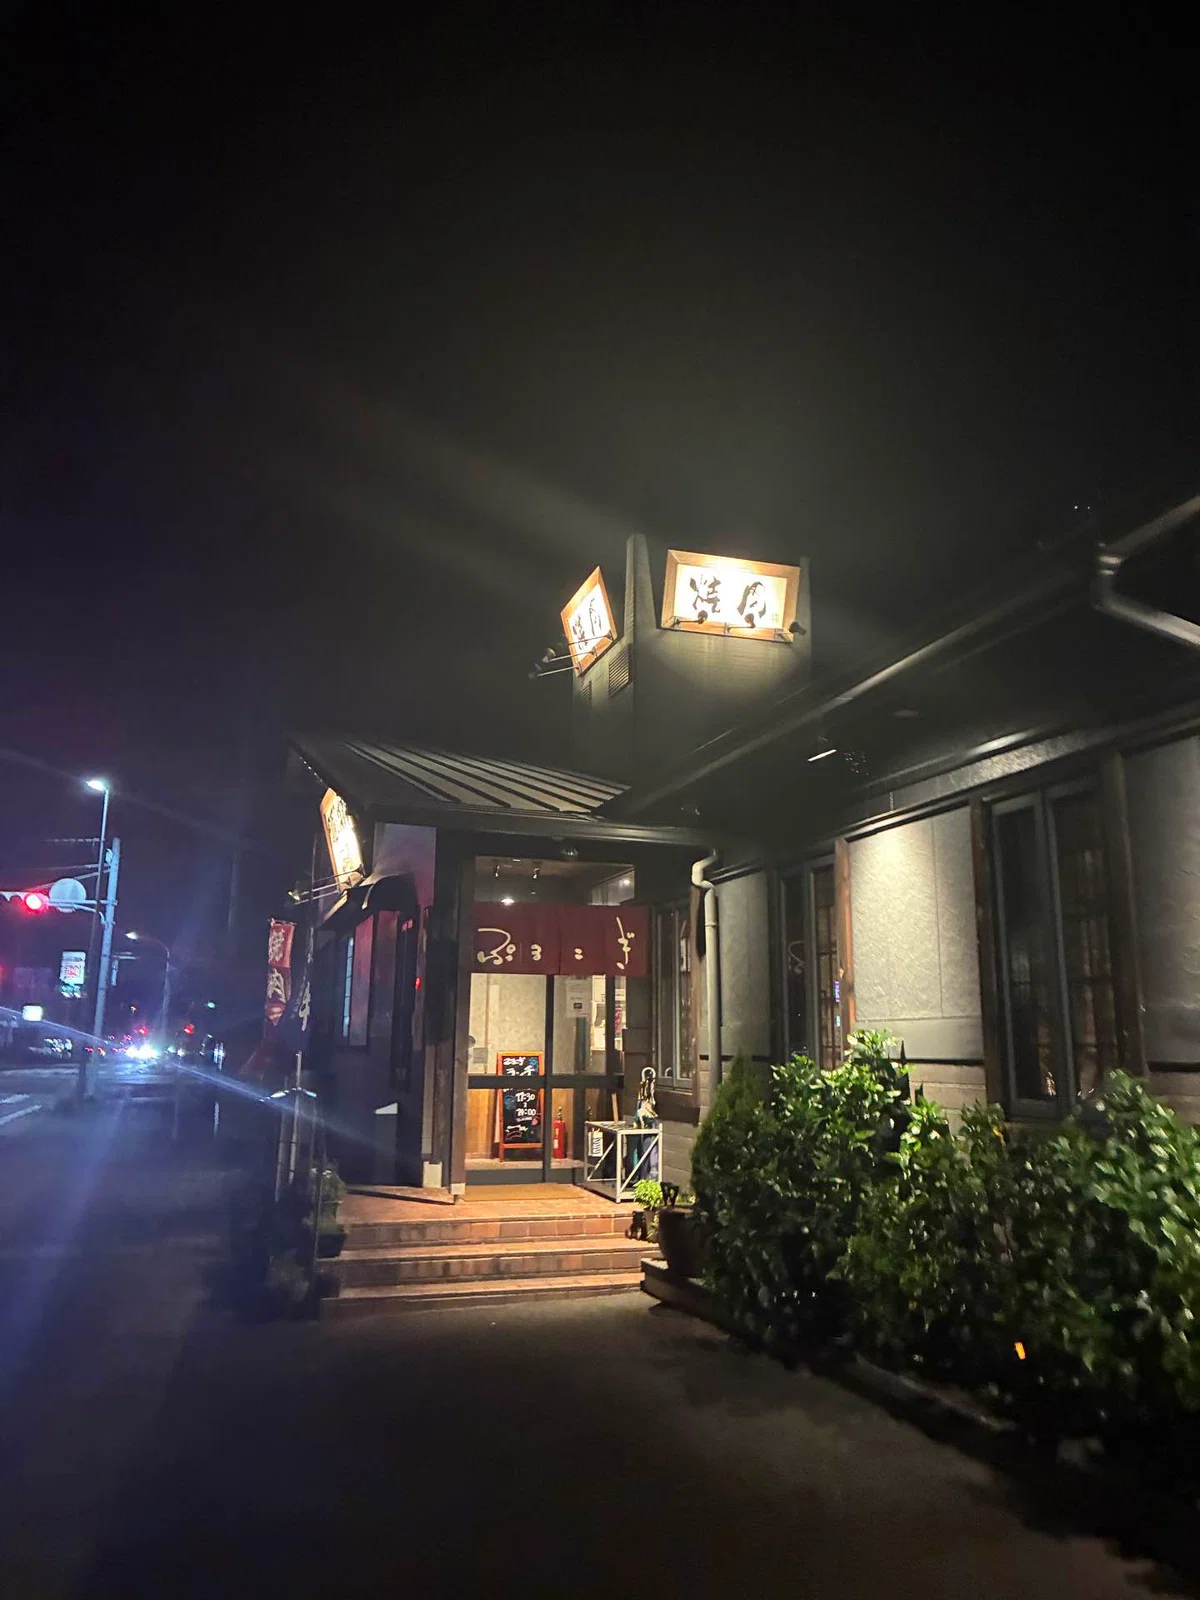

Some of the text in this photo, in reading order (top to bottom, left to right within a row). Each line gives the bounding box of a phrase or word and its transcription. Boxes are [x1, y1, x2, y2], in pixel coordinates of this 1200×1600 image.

[689, 573, 767, 618] 焼肉
[515, 1091, 536, 1102] 11:30
[515, 1108, 537, 1116] 14:00
